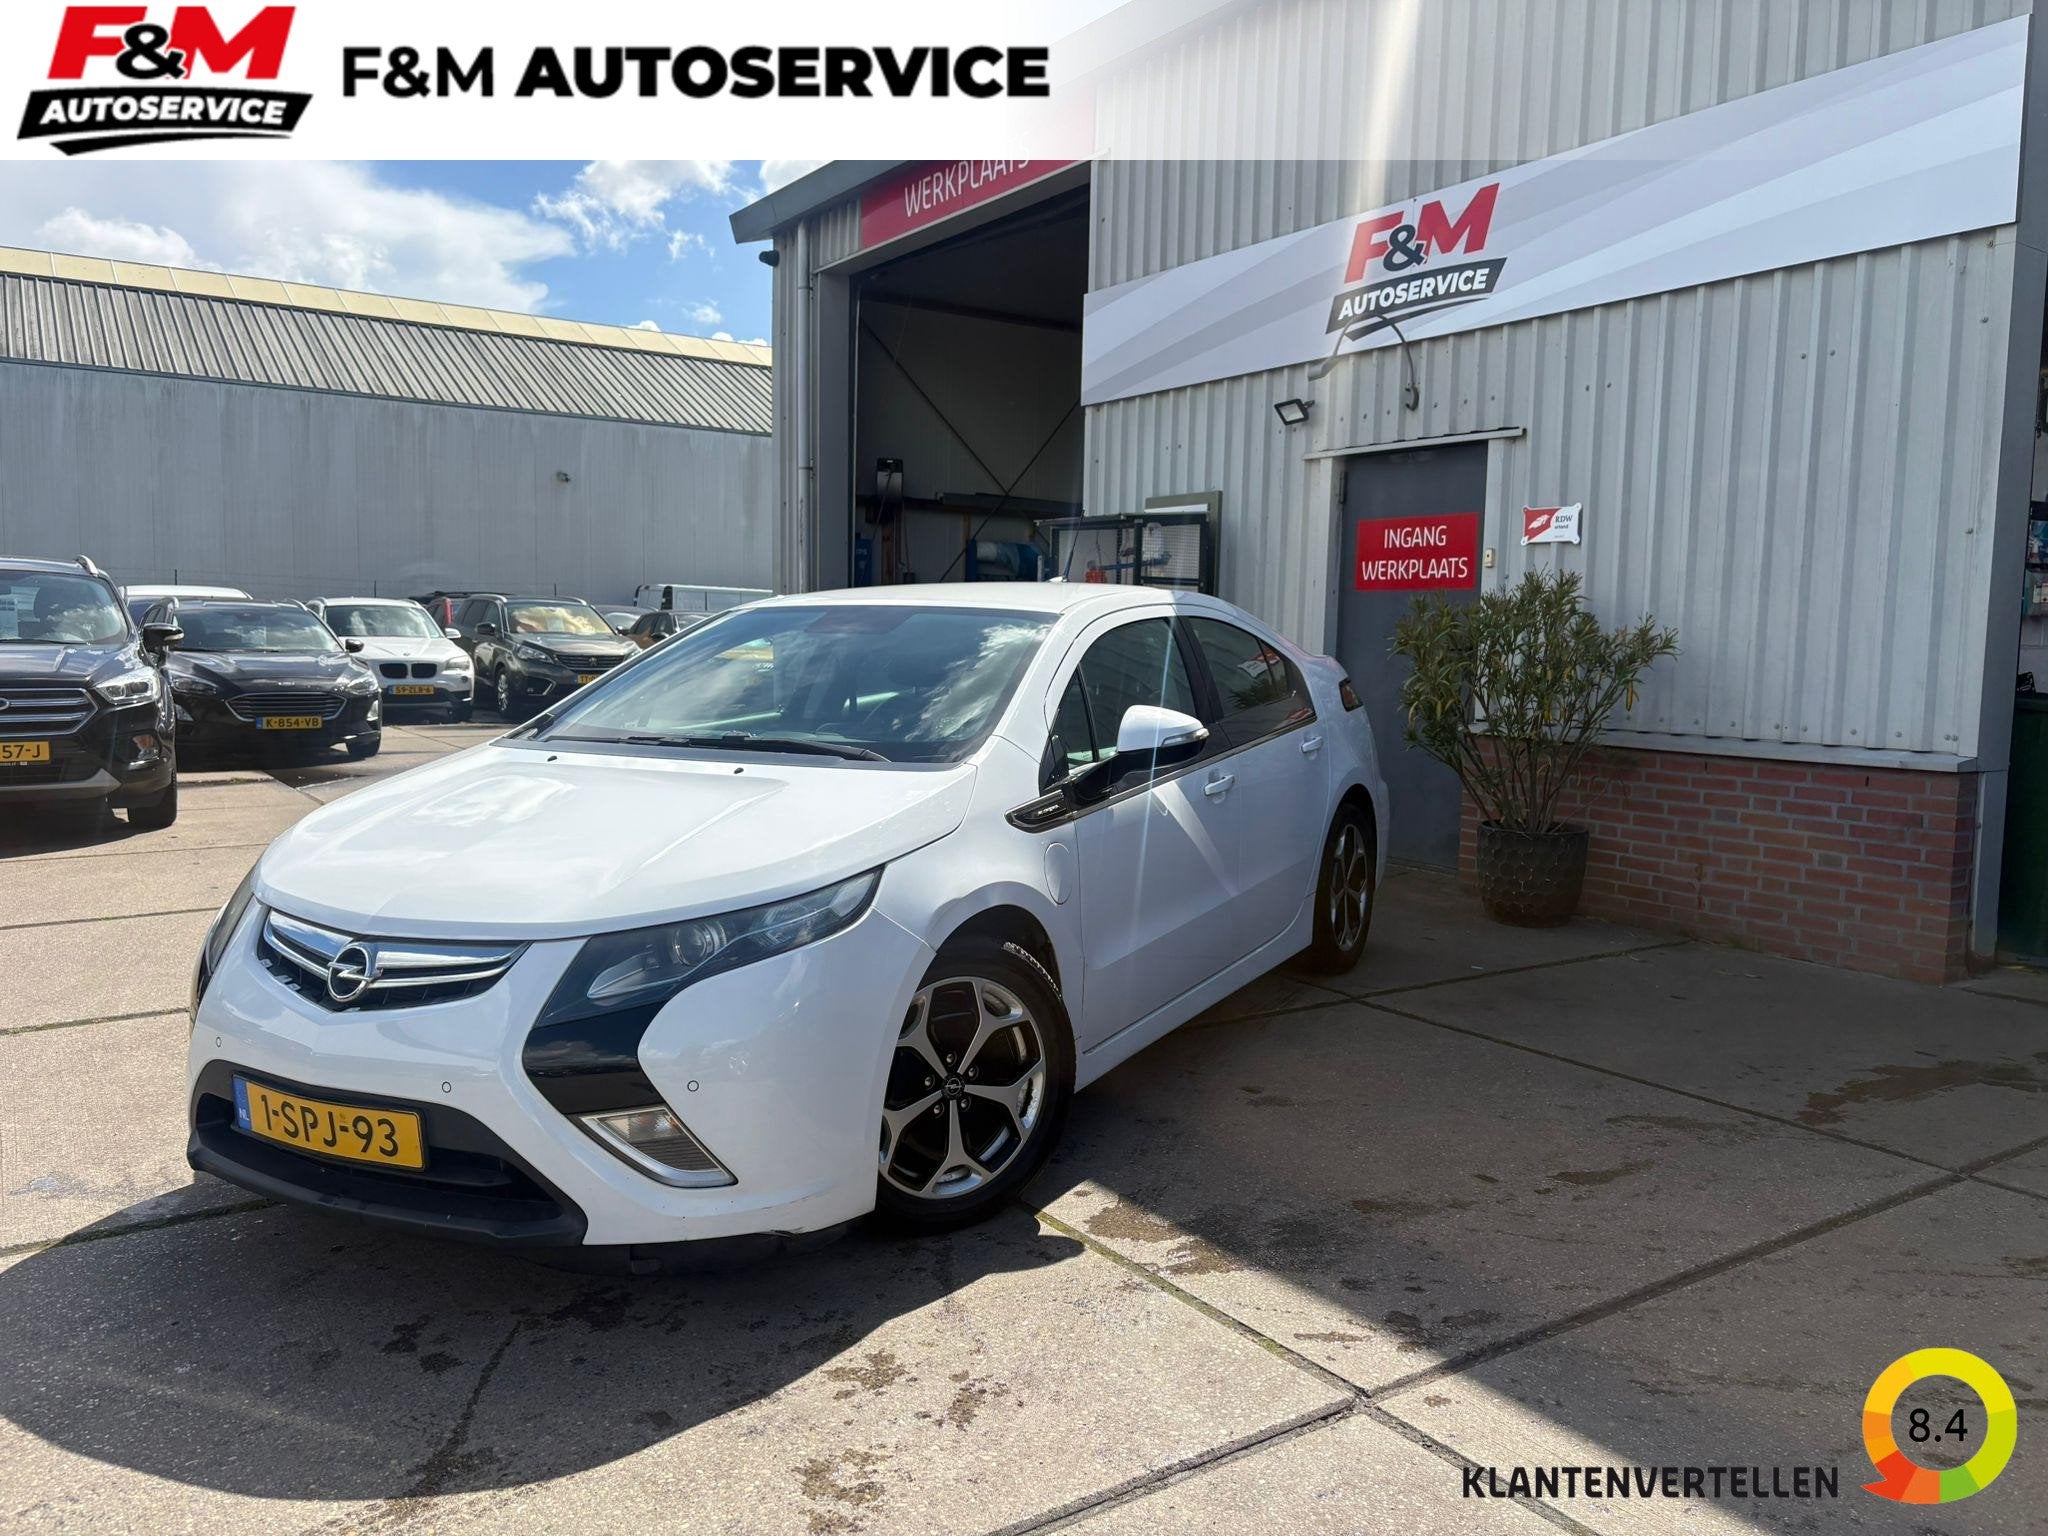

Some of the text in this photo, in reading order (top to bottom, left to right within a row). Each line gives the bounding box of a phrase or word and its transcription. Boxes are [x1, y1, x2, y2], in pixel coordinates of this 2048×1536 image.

[1344, 182, 1500, 284] F&M
[1337, 267, 1489, 321] AUTOSERVICE
[1383, 525, 1448, 549] INGANG
[1361, 556, 1468, 581] WERKPLAATS
[238, 1107, 250, 1122] NL
[260, 1094, 399, 1158] 1-SPJ-93
